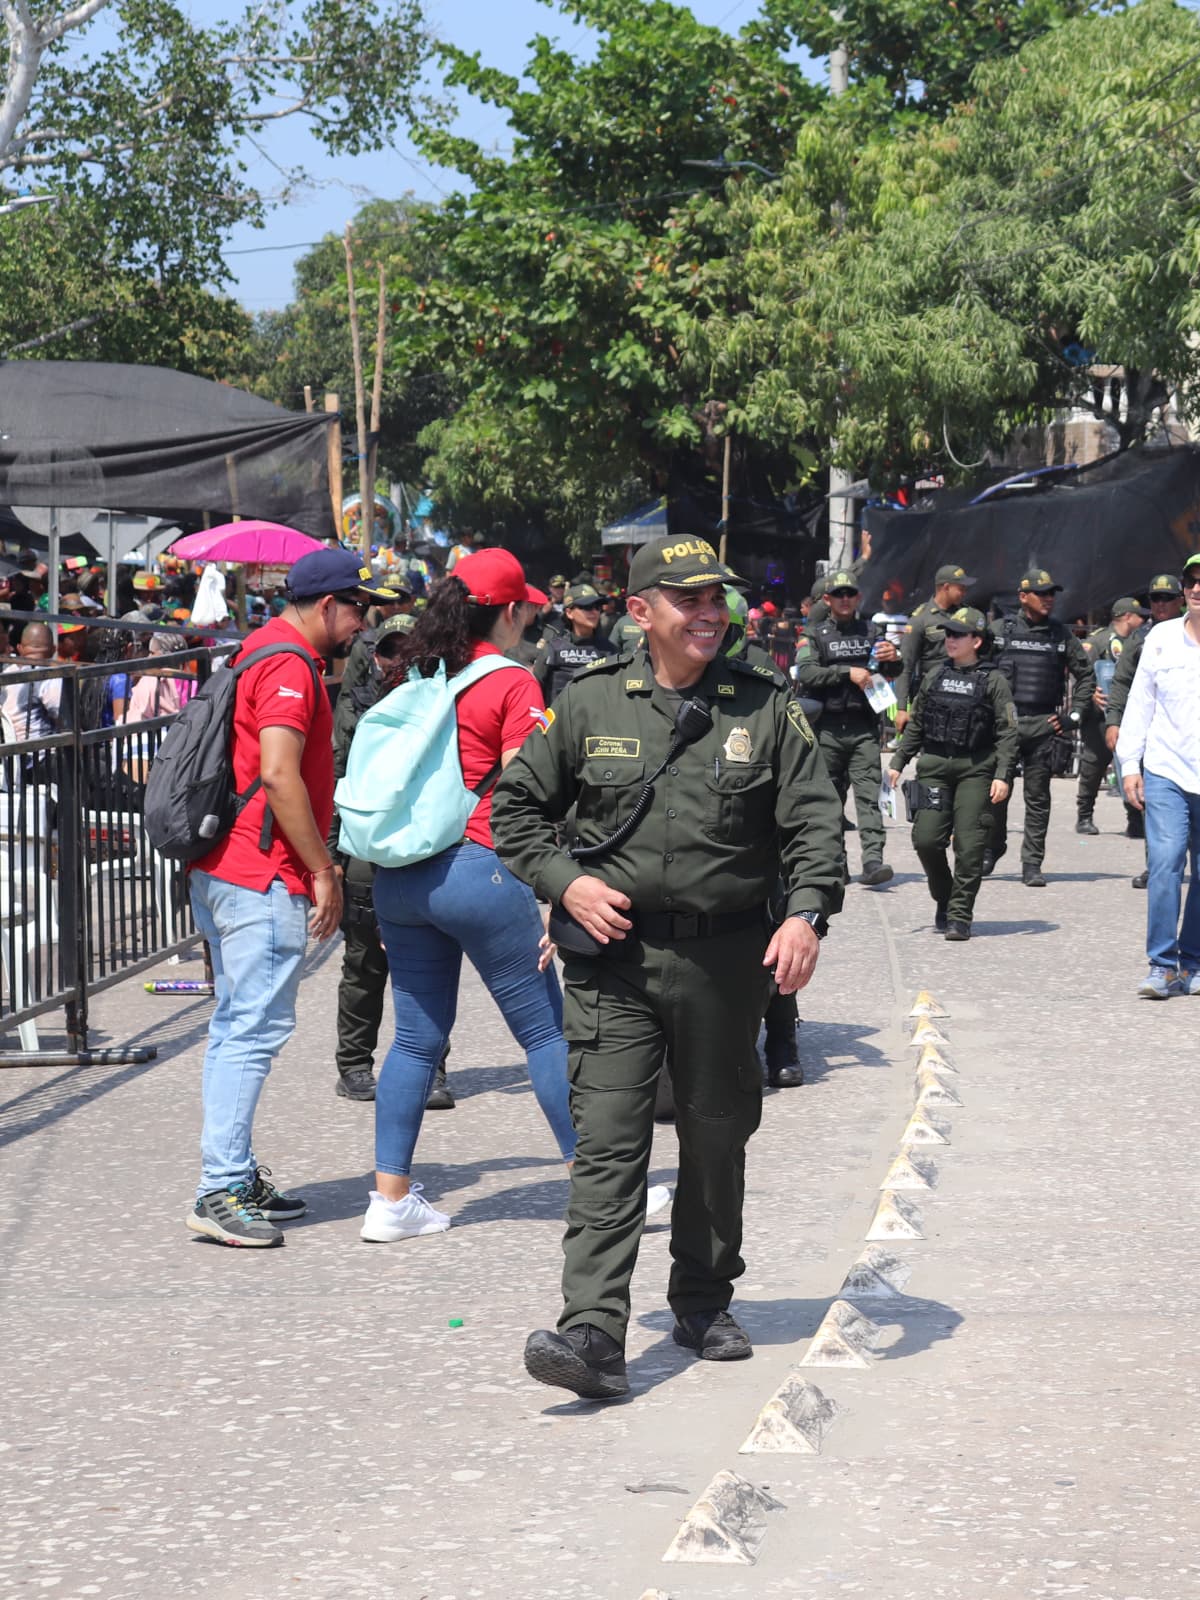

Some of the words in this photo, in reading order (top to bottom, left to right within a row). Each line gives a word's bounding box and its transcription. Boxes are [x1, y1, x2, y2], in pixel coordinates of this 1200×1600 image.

[662, 540, 717, 564] POLIC
[829, 639, 872, 651] GAULA
[560, 649, 598, 660] GAULA
[942, 679, 973, 690] GAULA
